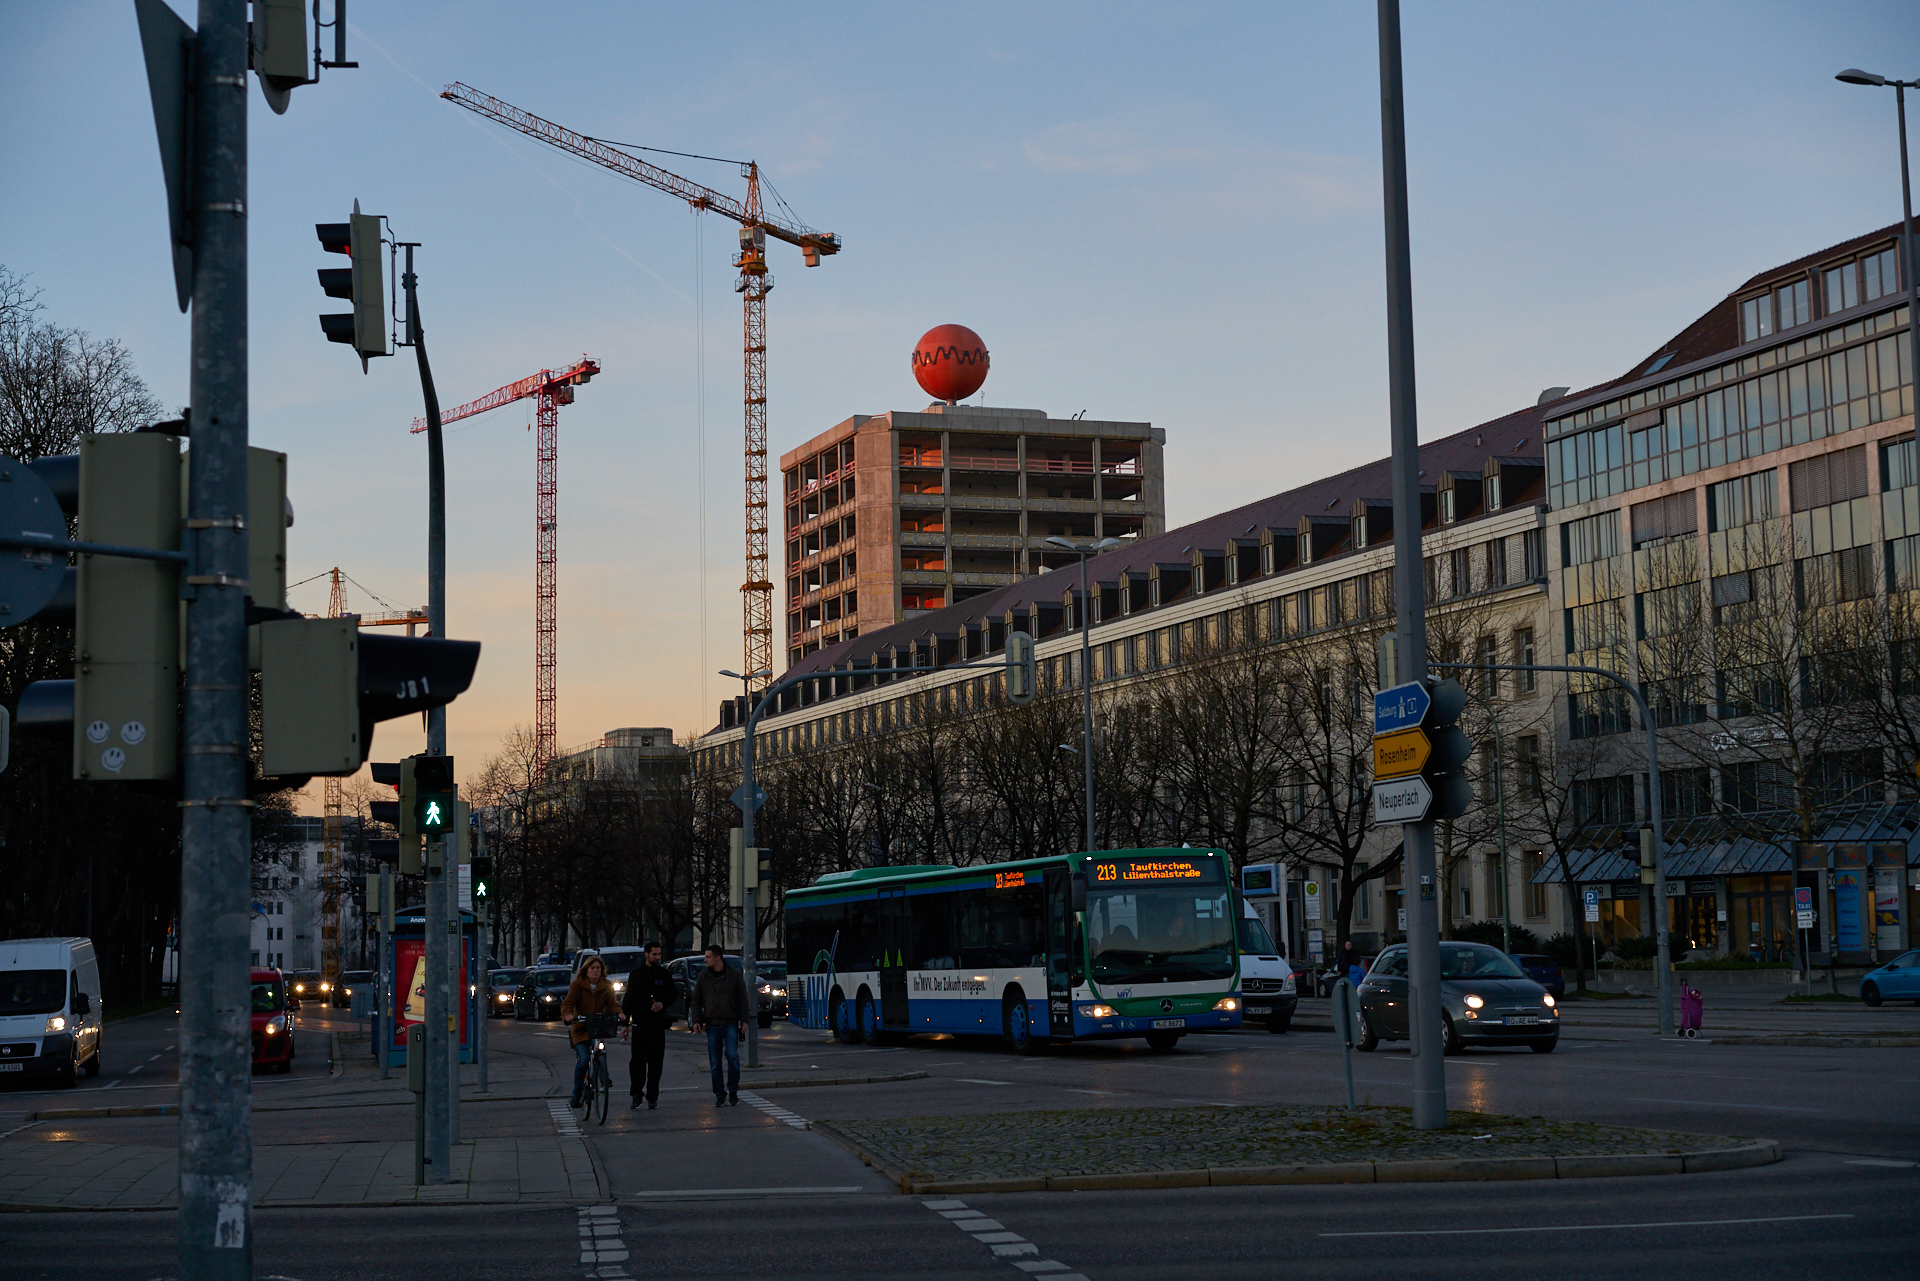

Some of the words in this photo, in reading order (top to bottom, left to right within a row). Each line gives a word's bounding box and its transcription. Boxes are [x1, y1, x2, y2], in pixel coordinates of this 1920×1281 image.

[1378, 704, 1397, 719] Salzburg
[1380, 744, 1417, 766] Rosenheim
[1379, 788, 1419, 812] Neuperlach
[1096, 864, 1118, 881] 213
[1130, 862, 1192, 872] Taufkirchen
[1122, 869, 1202, 880] Lilienthalstraße
[1586, 892, 1595, 904] P
[934, 977, 943, 991] Der
[943, 976, 961, 991] Zukunft
[961, 979, 987, 995] entgegen.
[1506, 1017, 1515, 1025] RO
